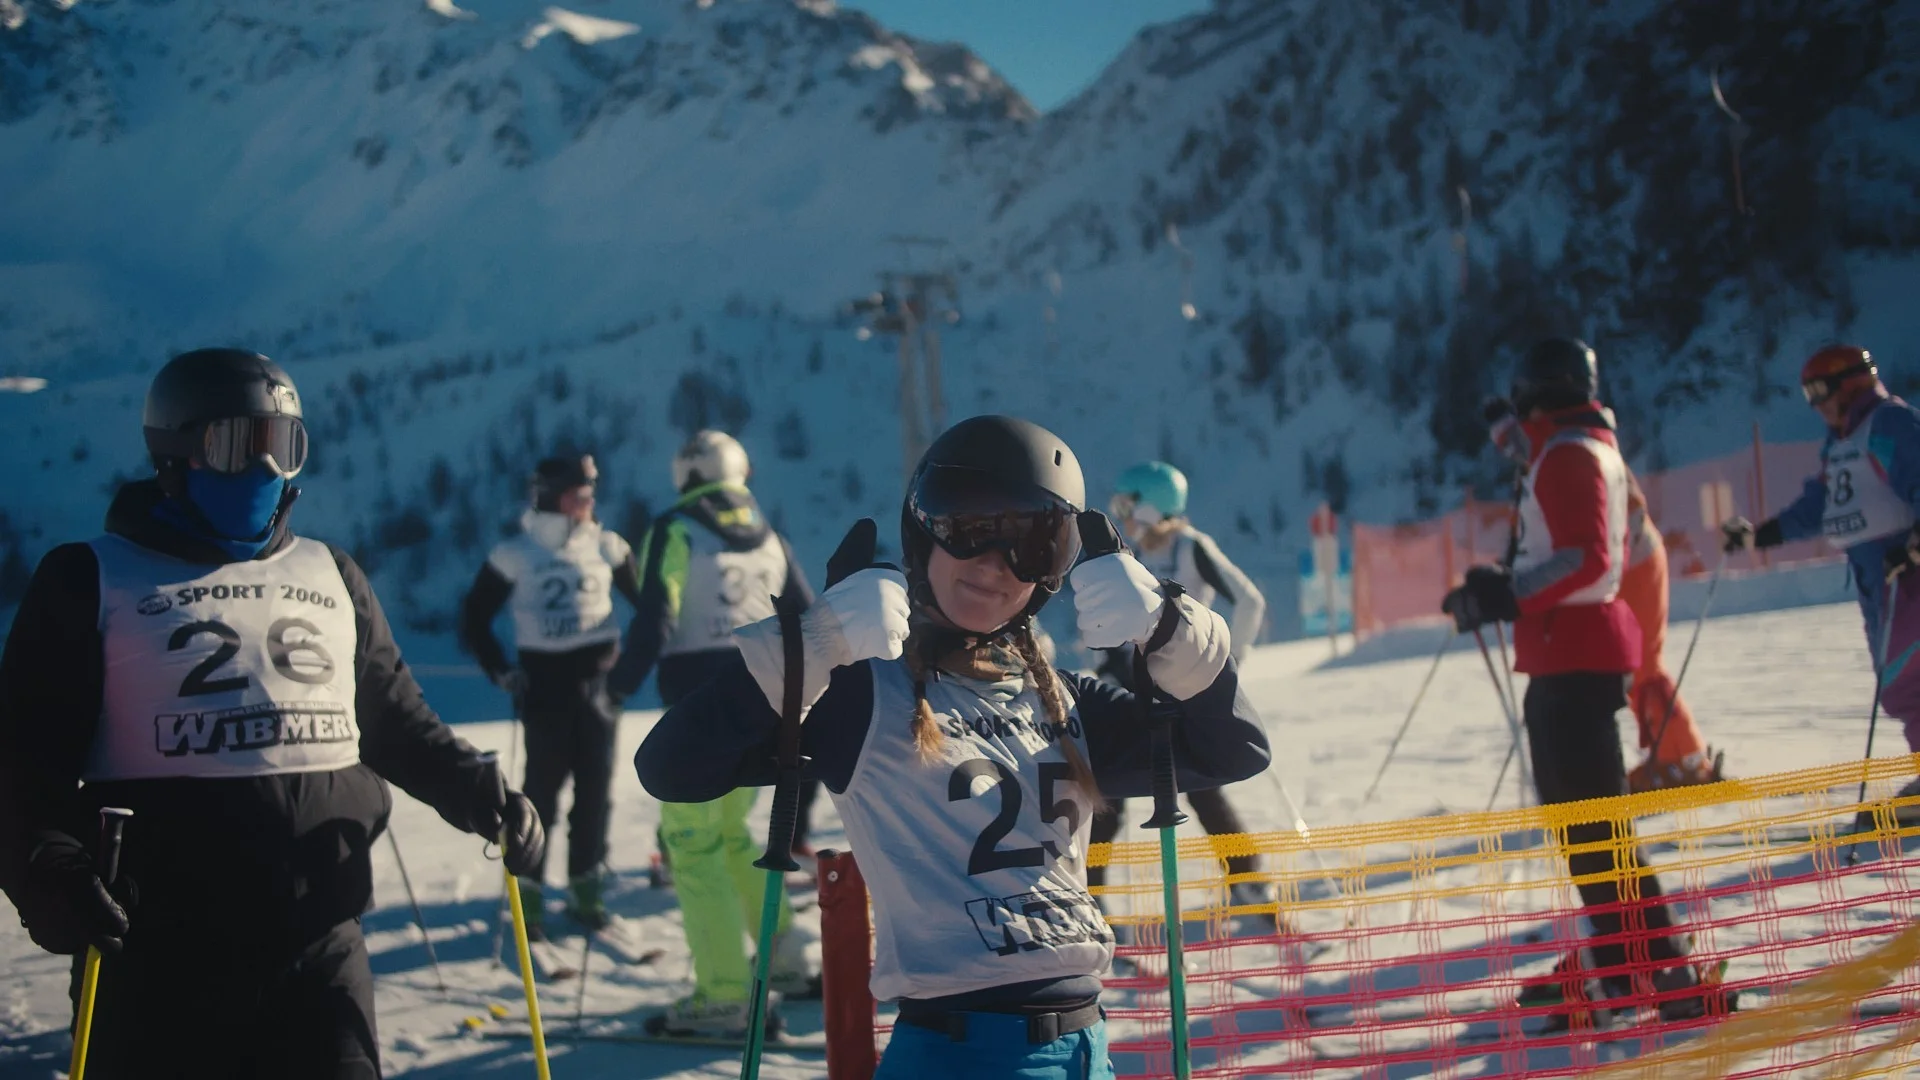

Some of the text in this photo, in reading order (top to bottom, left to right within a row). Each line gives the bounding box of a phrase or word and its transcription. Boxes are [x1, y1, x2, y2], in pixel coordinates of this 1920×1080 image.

[177, 584, 266, 606] SPORT
[280, 584, 337, 609] 2000
[167, 617, 336, 697] 26
[155, 711, 354, 756] WIBMER
[948, 758, 1080, 876] 25
